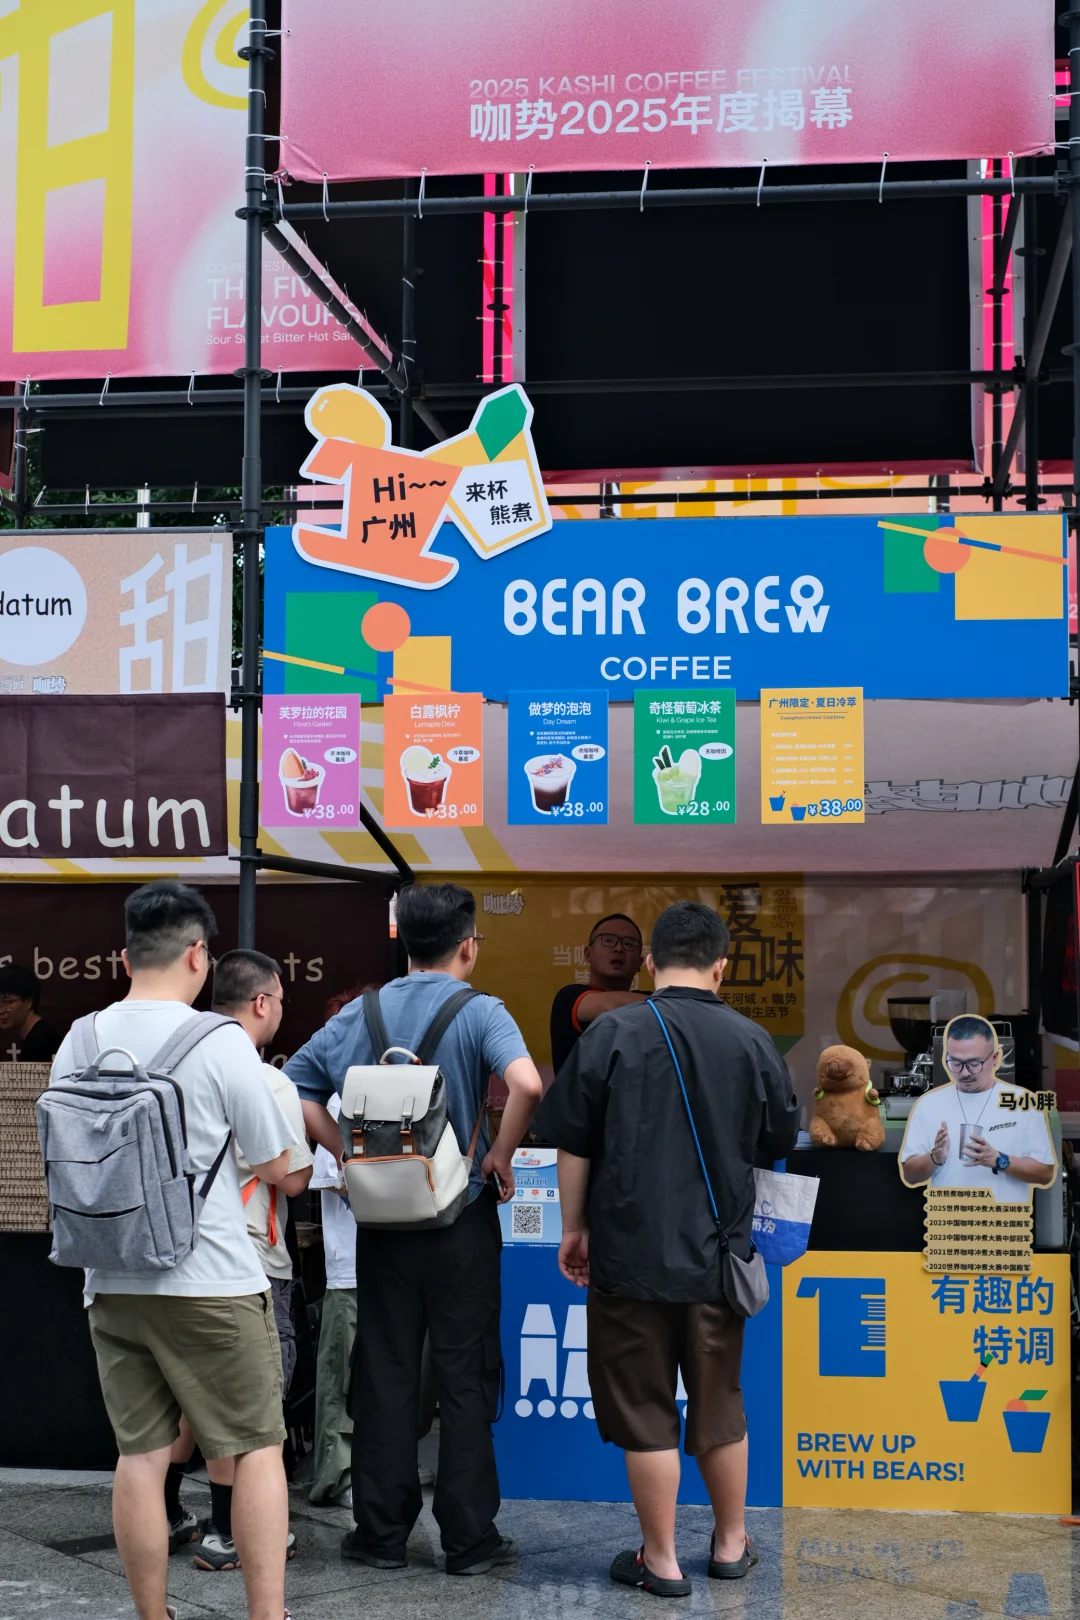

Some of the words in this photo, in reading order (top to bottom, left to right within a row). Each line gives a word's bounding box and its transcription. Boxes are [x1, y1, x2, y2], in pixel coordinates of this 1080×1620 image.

[469, 78, 529, 99] 2025
[540, 75, 615, 97] KASHI
[625, 70, 727, 93] COFFEE
[736, 64, 855, 89] FESTIVAL
[469, 86, 853, 142] 咖势2025年度揭幕
[205, 334, 231, 344] Sour
[273, 332, 304, 343] Bitter
[308, 331, 329, 341] Hot
[465, 480, 508, 502] 来杯
[489, 502, 533, 526] 熊煮
[361, 512, 417, 544] 广州
[503, 578, 646, 636] BEAR
[677, 575, 831, 634] BREW
[600, 656, 732, 681] COFFEE
[279, 706, 347, 720] 芙罗拉的花园
[410, 704, 460, 719] 白露枫柠
[528, 702, 592, 716] 做梦的泡泡
[649, 701, 721, 715] 奇怪葡萄冰茶
[303, 804, 354, 819] ¥38.00
[425, 803, 477, 819] ¥38.00
[552, 802, 604, 816] ¥38.00
[678, 801, 730, 816] ¥28.00
[808, 799, 862, 816] ¥38.00
[33, 946, 123, 980] best
[771, 992, 797, 1005] 咖势
[999, 1092, 1055, 1112] 马小胖
[931, 1275, 1054, 1316] 有趣的
[973, 1325, 1054, 1366] 特调
[796, 1433, 875, 1453] BREW
[882, 1434, 916, 1454] UP
[796, 1459, 865, 1480] WITH
[873, 1461, 965, 1482] BEARS!
